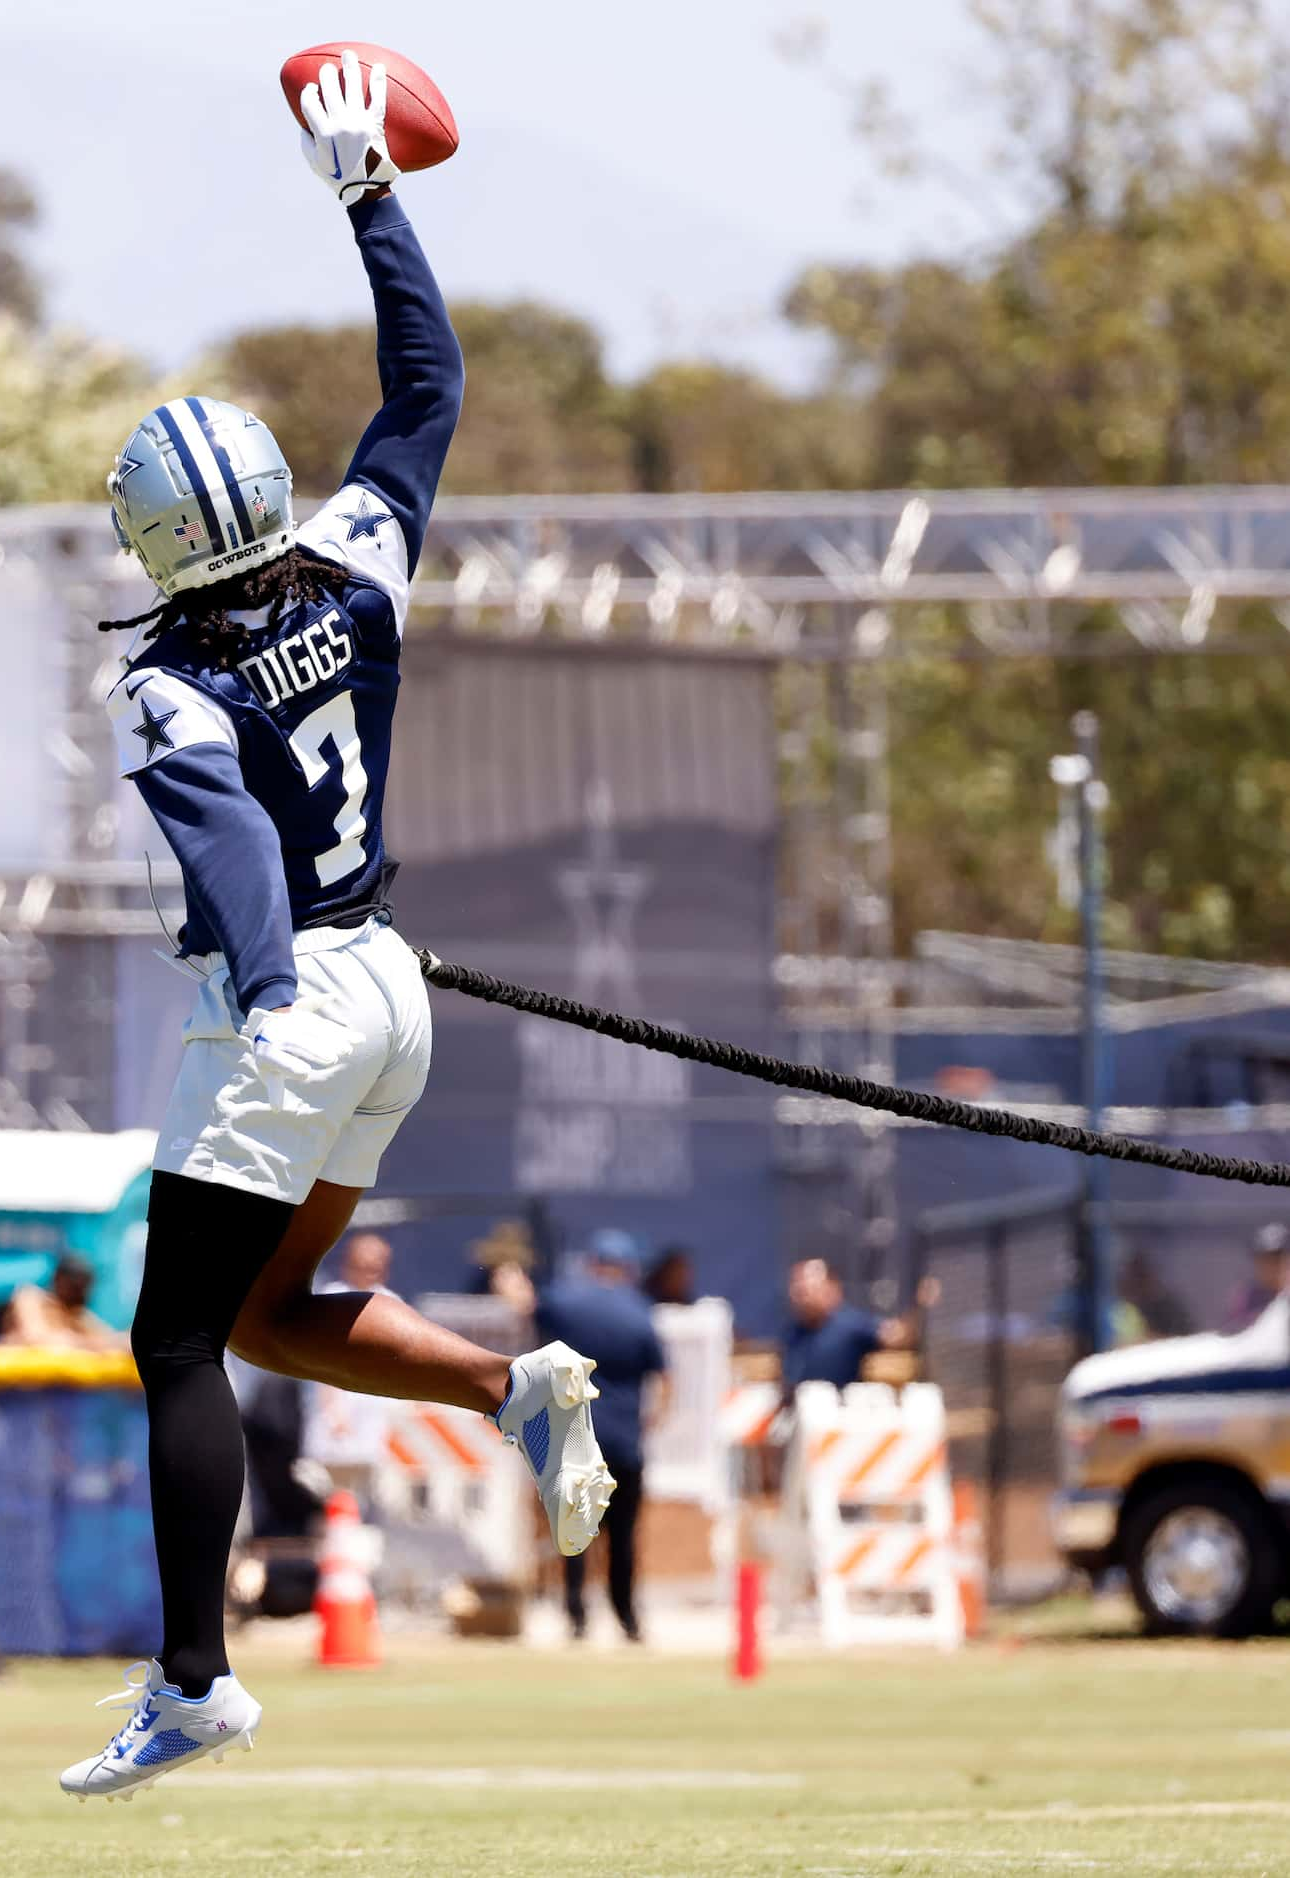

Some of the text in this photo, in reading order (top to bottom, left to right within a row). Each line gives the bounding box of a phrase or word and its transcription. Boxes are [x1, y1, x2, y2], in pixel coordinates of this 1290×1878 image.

[207, 542, 267, 572] COWBOYS
[237, 609, 353, 710] DIGGS
[288, 689, 368, 889] 7
